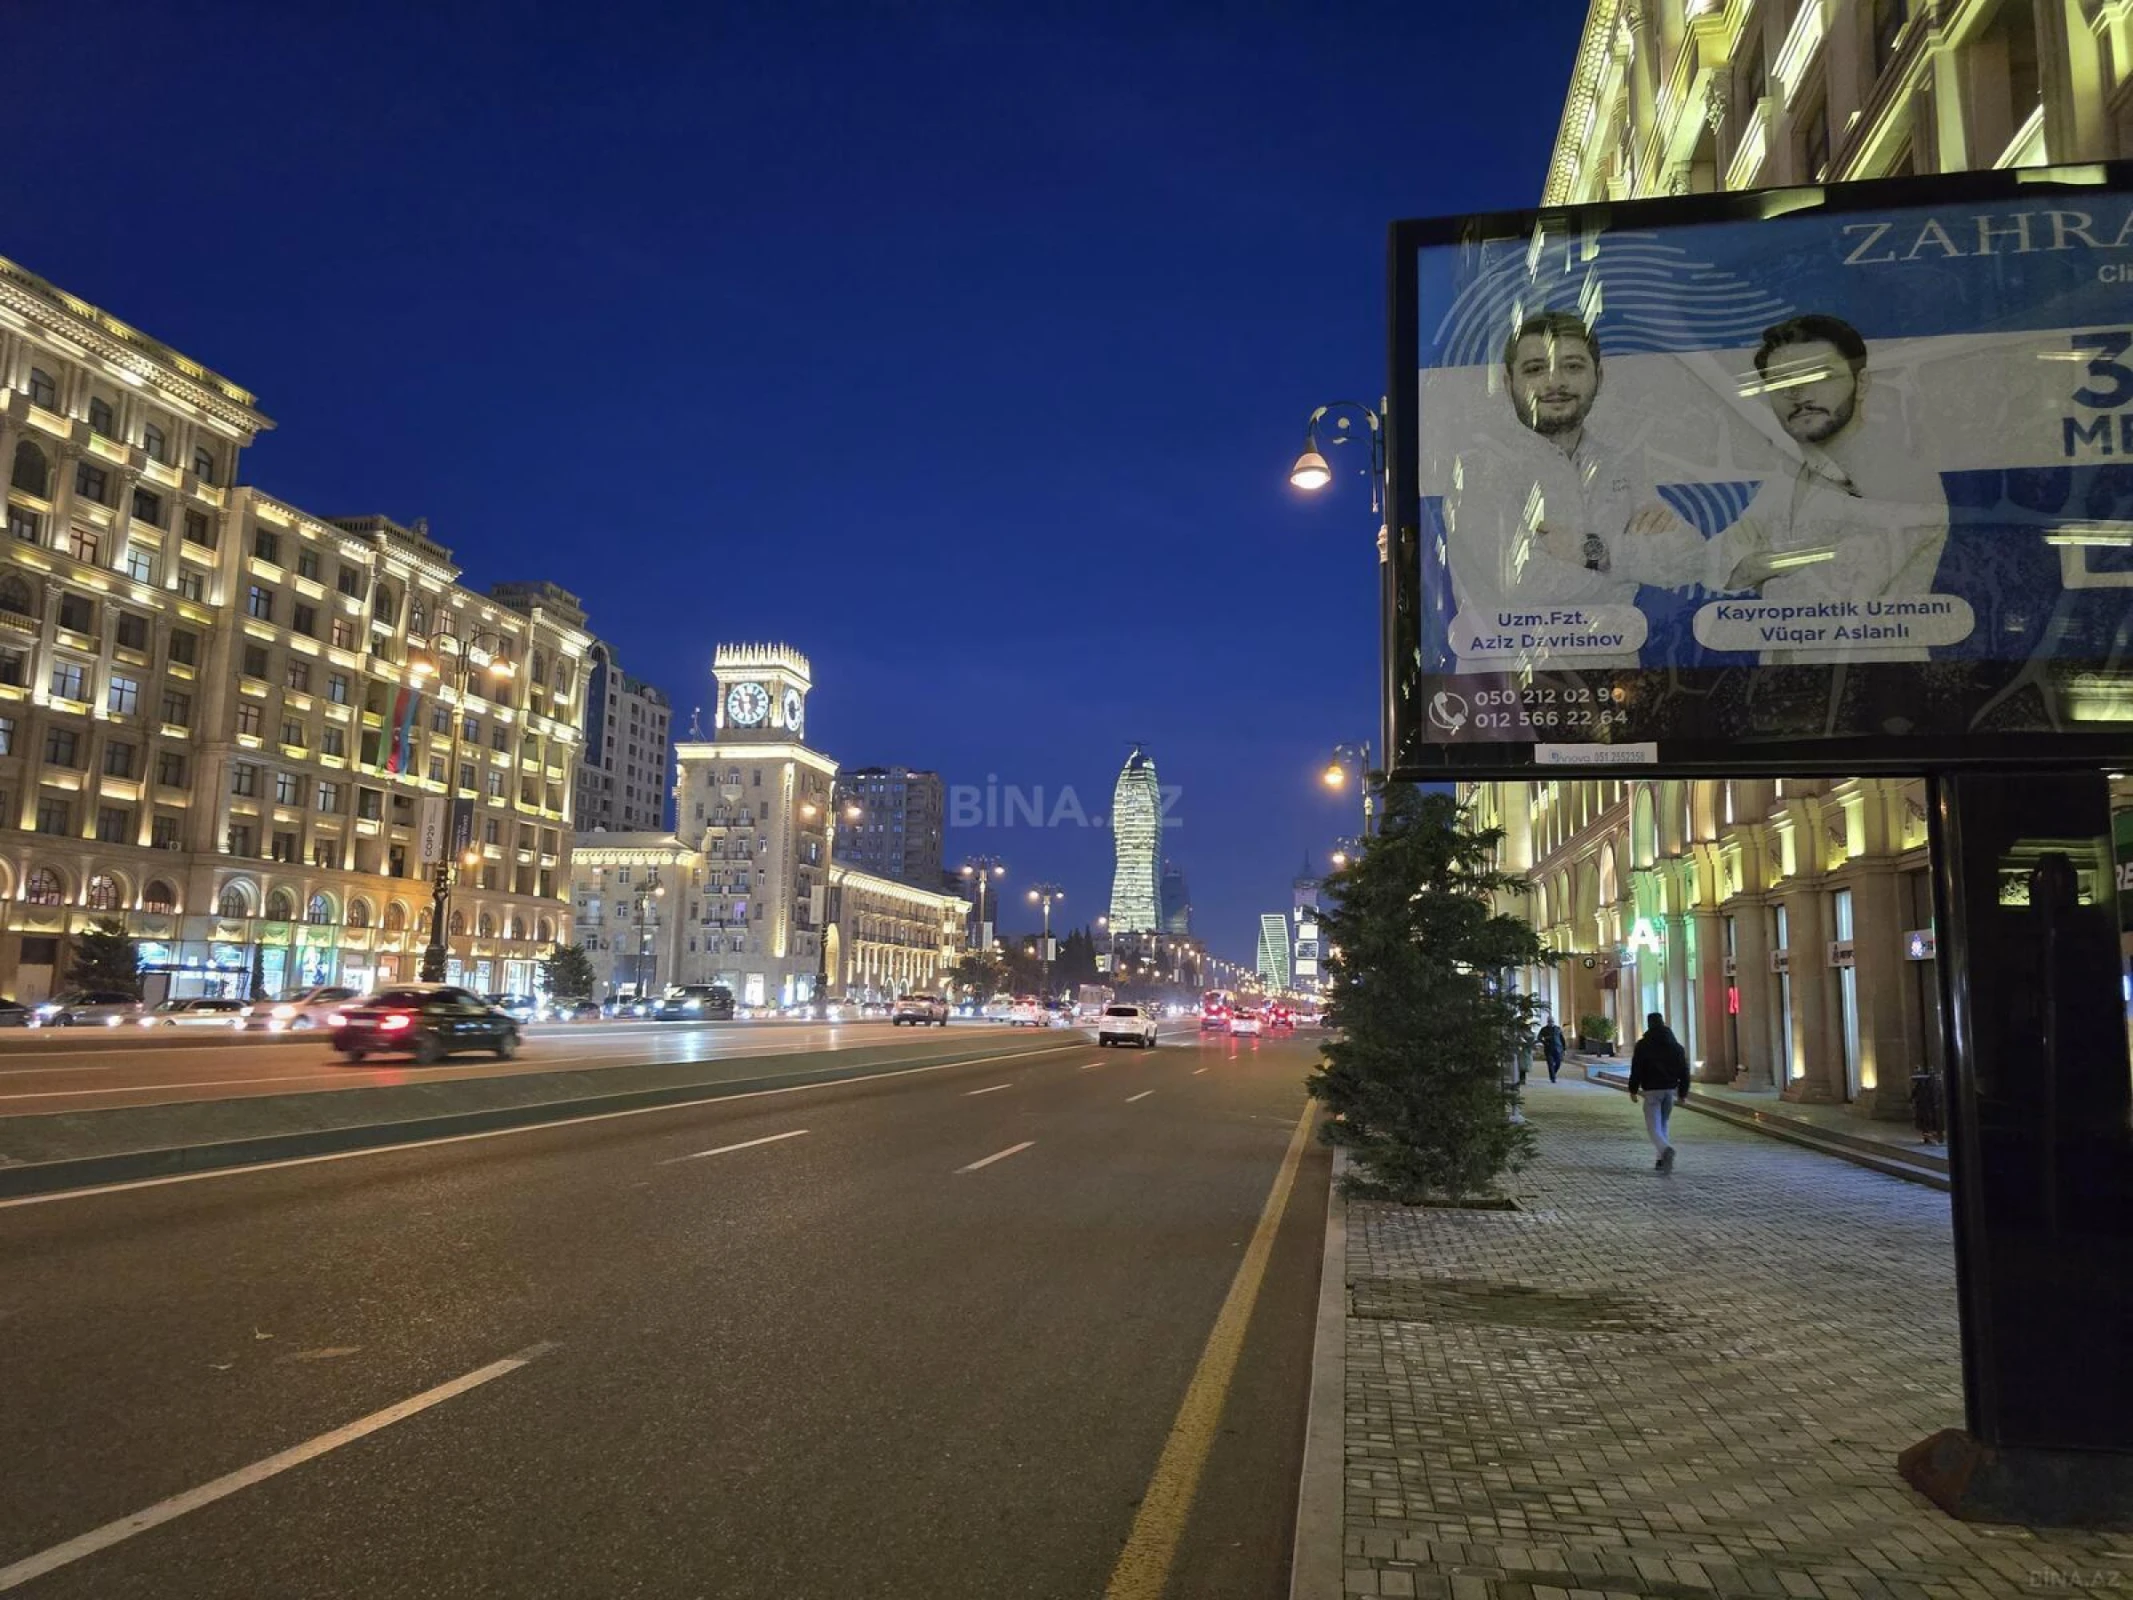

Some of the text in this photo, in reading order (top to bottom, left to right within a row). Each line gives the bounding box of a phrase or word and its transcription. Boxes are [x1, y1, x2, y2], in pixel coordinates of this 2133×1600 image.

[1498, 611, 1588, 627] Uzm.Fzt.
[1717, 600, 1951, 622] Kayropraktik Uzmanı
[1471, 634, 1514, 650] Aziz
[1760, 624, 1909, 645] Vüqar Aslanlı
[1475, 691, 1516, 706] 050
[1523, 689, 1555, 704] 212
[1564, 688, 1590, 703] 02
[1475, 710, 1628, 728] 012 566 22 64
[425, 825, 435, 857] COP29
[1626, 917, 1660, 953] A
